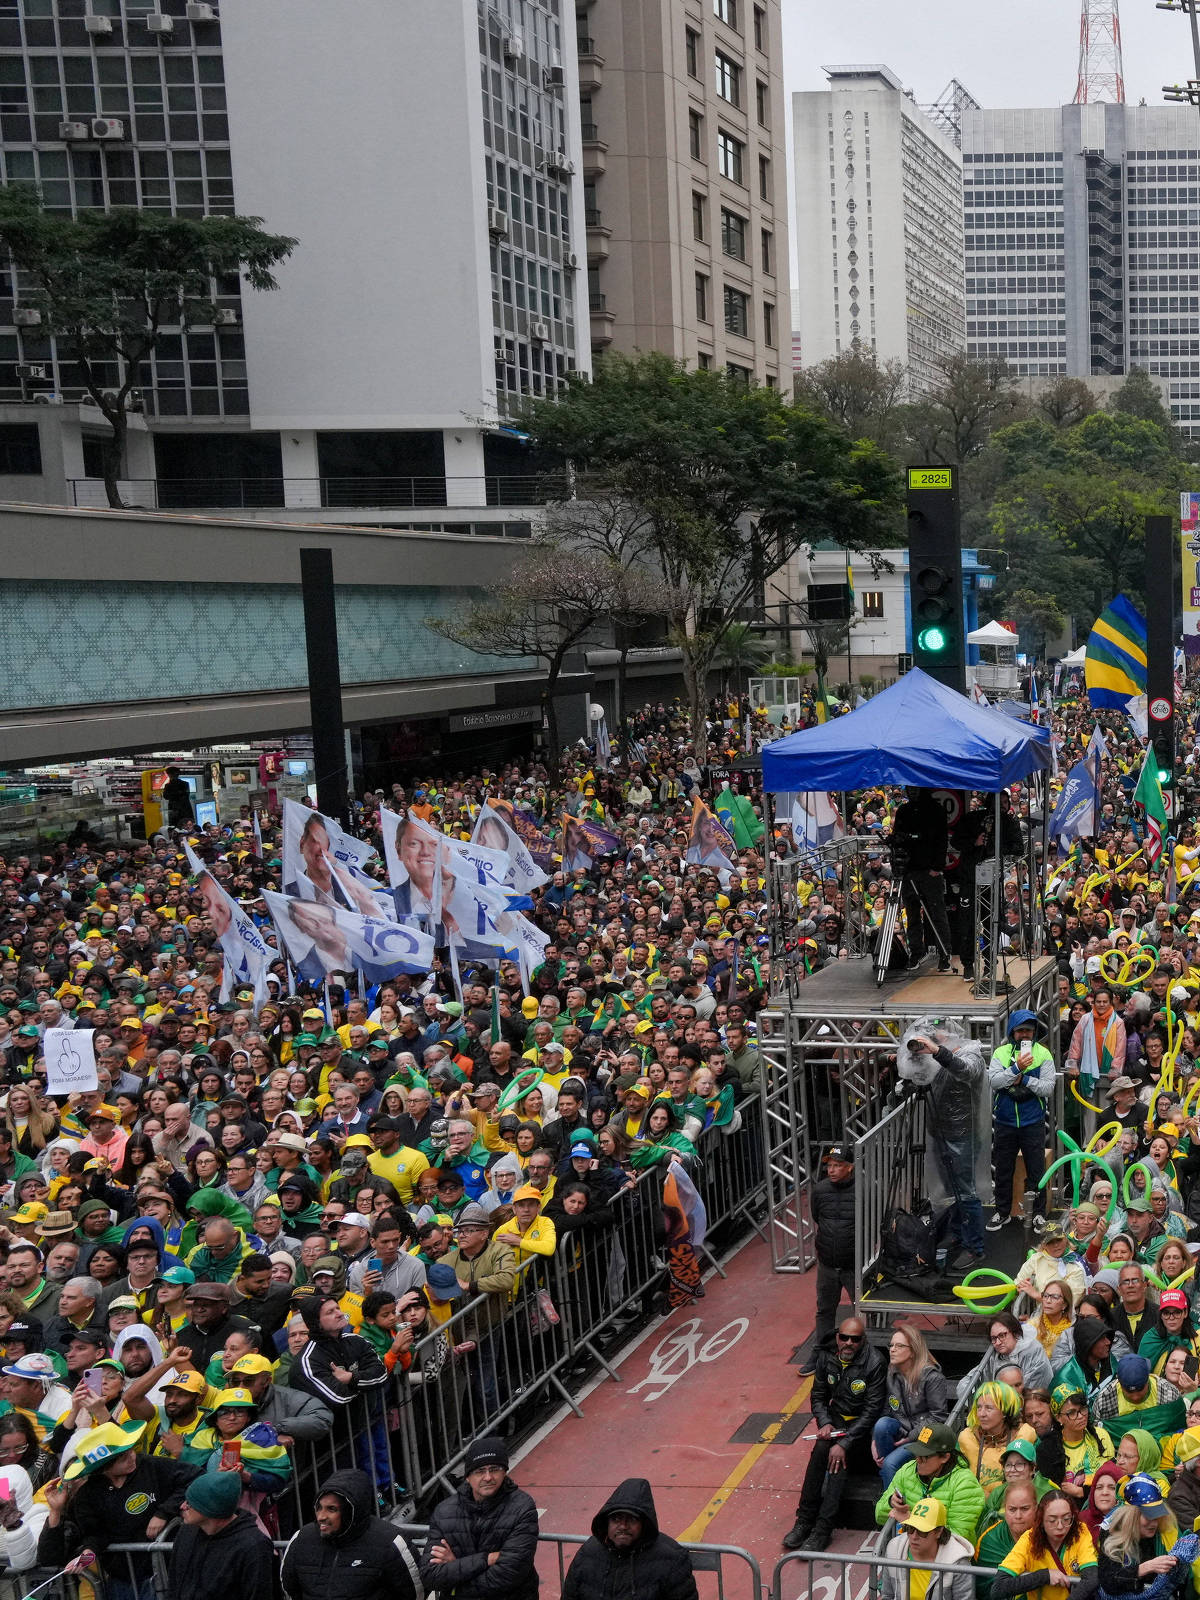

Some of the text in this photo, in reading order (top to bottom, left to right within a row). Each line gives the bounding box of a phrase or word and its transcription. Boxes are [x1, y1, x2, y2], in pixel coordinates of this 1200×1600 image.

[921, 474, 948, 484] 2825
[359, 925, 420, 957] 10
[173, 1373, 189, 1384] 22
[86, 1445, 109, 1462] 10
[127, 1493, 147, 1510] 222
[914, 1504, 929, 1517] 22
